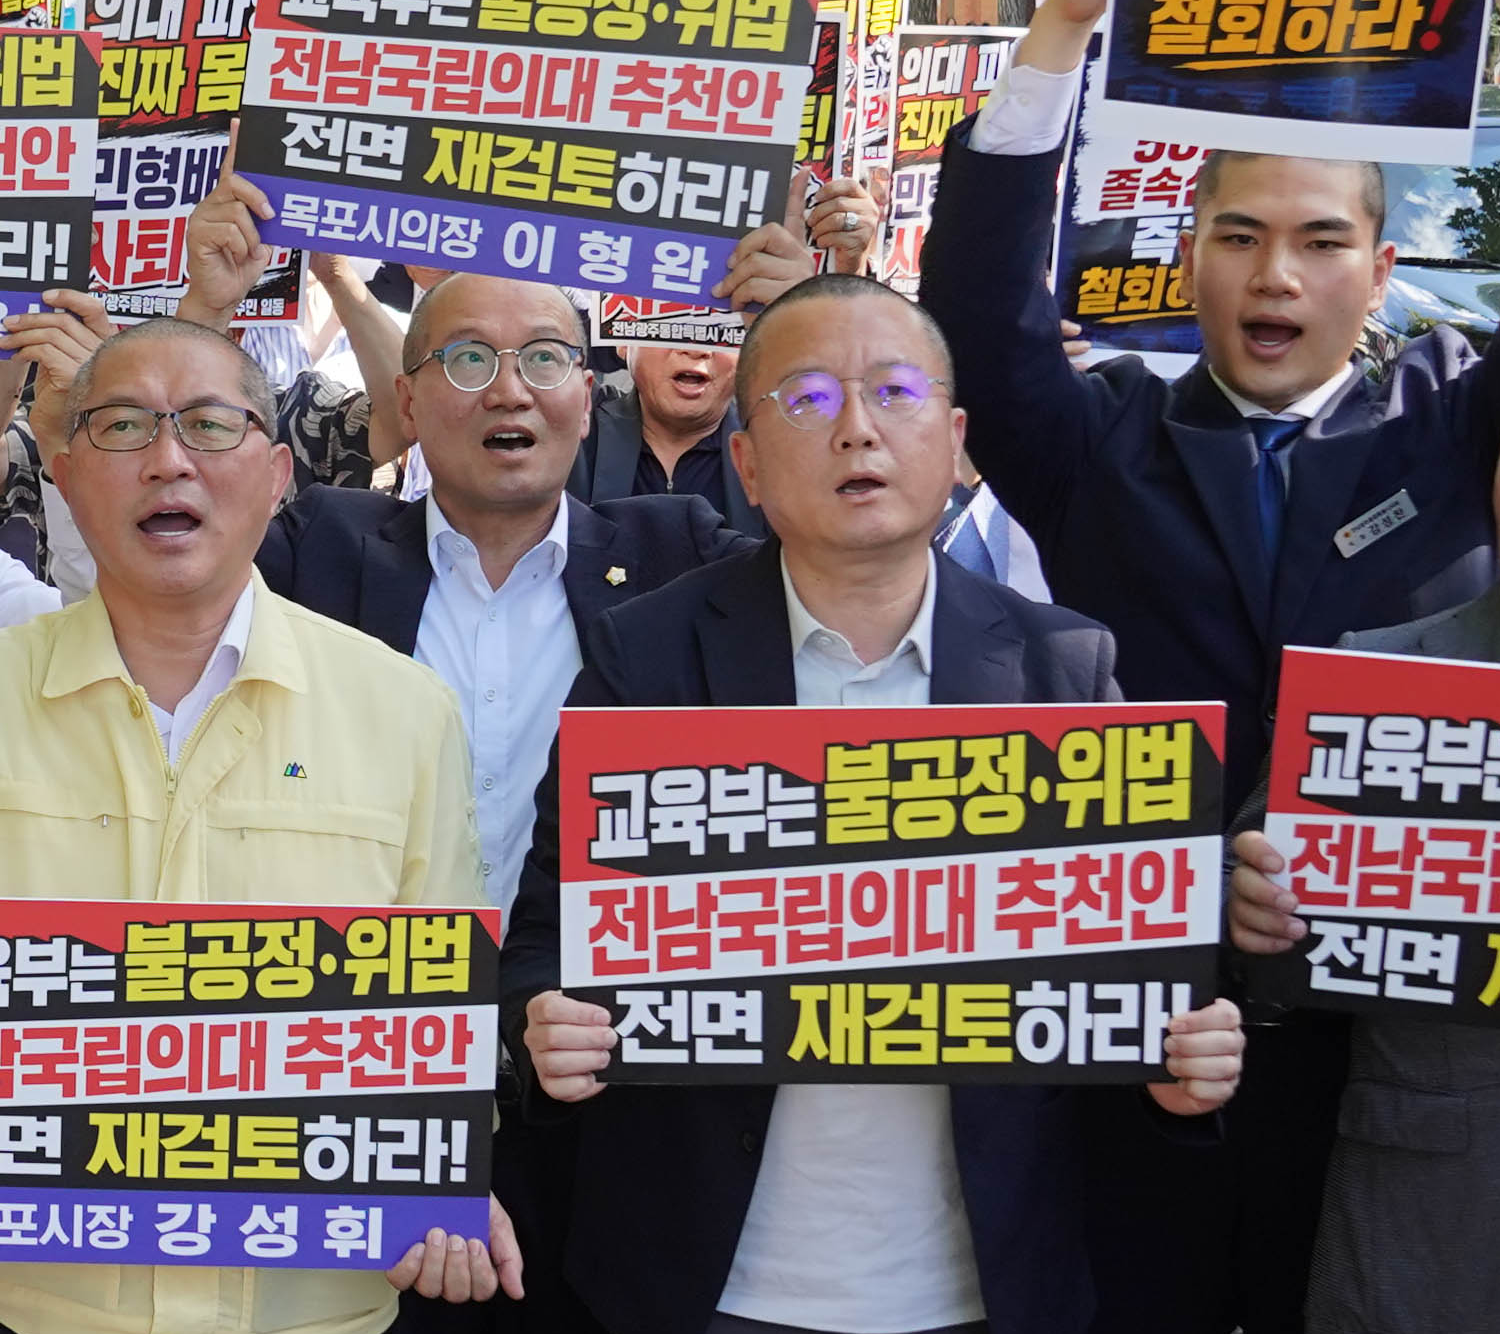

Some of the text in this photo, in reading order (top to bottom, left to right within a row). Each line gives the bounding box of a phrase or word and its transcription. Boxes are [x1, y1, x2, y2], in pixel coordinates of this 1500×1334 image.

[98, 45, 186, 116] 진짜
[269, 36, 599, 126] 전남국립의대
[609, 61, 784, 139] 추천안
[899, 43, 964, 96] 의대
[280, 114, 408, 181] 전면
[423, 125, 766, 229] 재검토하라!
[280, 193, 482, 259] 목포시의장
[261, 299, 284, 315] 일동
[612, 321, 718, 341] 전남광주통합특별시
[590, 765, 817, 861] 교육부는
[588, 848, 1195, 977] 전남국립의대 추천안
[1307, 921, 1461, 1005] 전면
[284, 1014, 474, 1090] 추천안
[613, 990, 764, 1064] 전면
[85, 1112, 468, 1184] 재검토하라!
